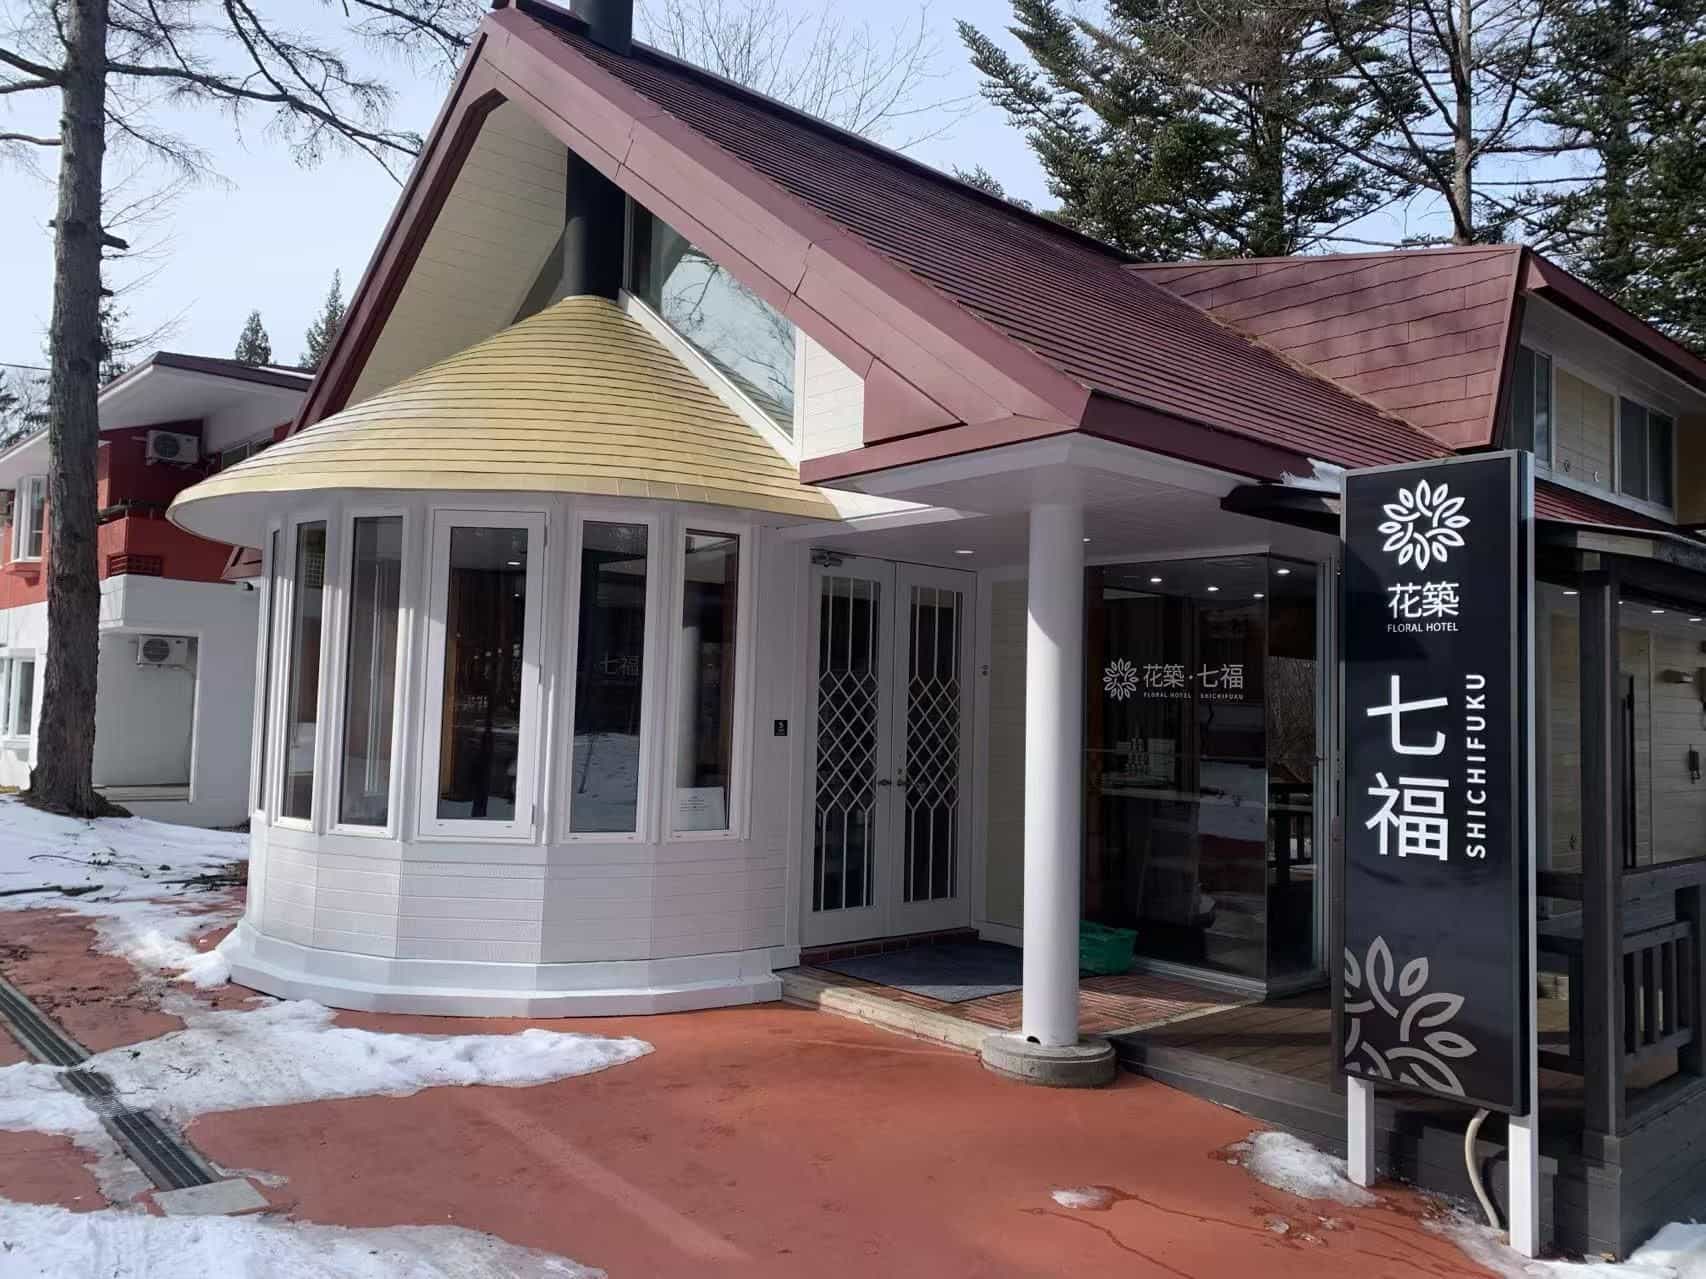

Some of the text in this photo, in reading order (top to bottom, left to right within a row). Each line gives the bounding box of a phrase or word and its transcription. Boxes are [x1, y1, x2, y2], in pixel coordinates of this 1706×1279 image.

[1387, 581, 1460, 619] 花築
[1387, 622, 1459, 633] FLORAL HOTEL
[1364, 674, 1450, 861] 七福
[1465, 674, 1487, 859] SHICHIFUKU
